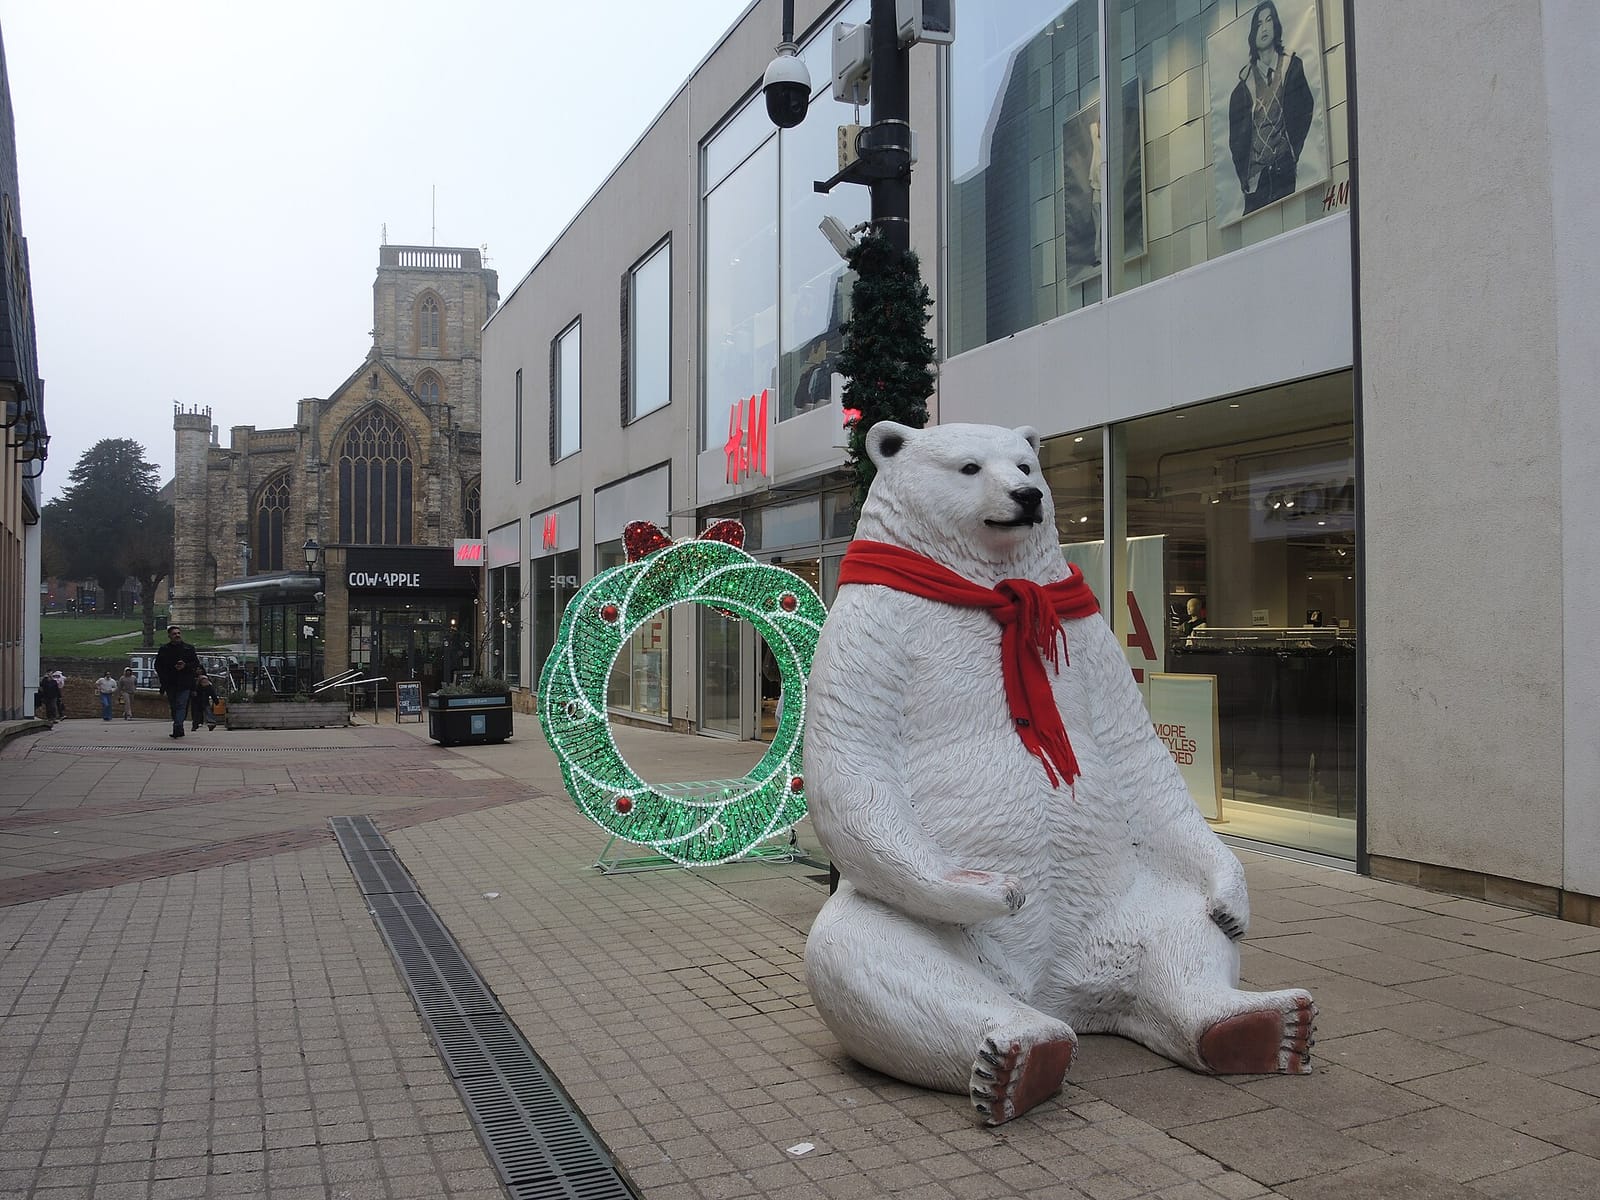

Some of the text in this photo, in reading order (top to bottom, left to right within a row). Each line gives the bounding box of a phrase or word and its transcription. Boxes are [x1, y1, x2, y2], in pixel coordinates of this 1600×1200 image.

[723, 388, 768, 485] H&M
[1153, 723, 1186, 738] MORE
[1160, 737, 1197, 753] TYLES
[1169, 751, 1193, 765] DED
